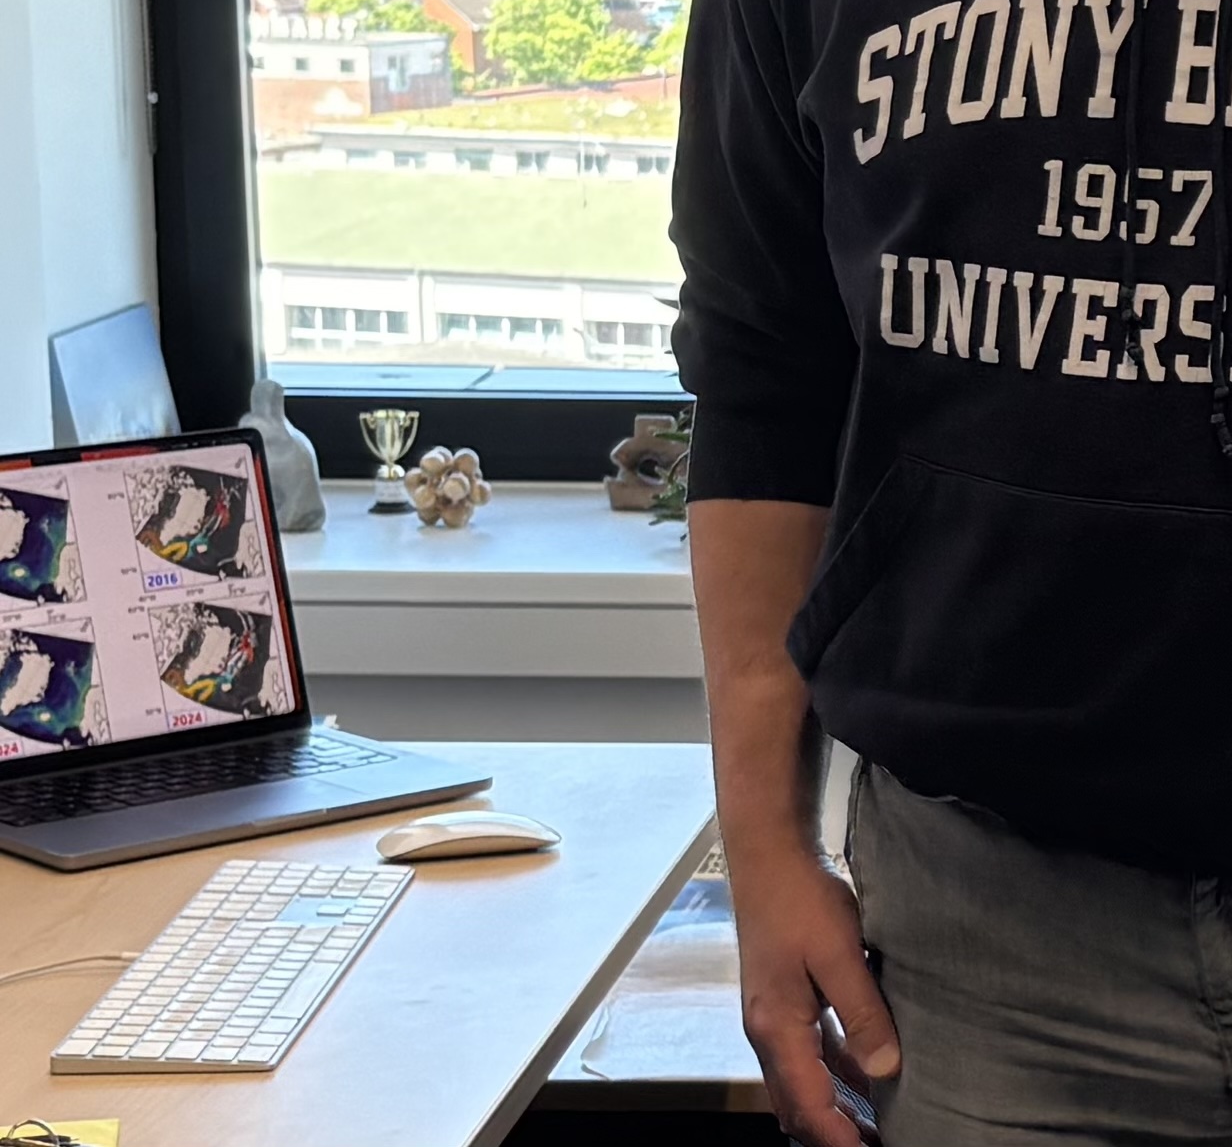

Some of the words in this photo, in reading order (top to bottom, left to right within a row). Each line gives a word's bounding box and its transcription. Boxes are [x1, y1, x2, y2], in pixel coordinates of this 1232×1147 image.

[1037, 159, 1213, 247] 1957
[148, 574, 178, 587] 2016
[173, 714, 202, 727] 2024
